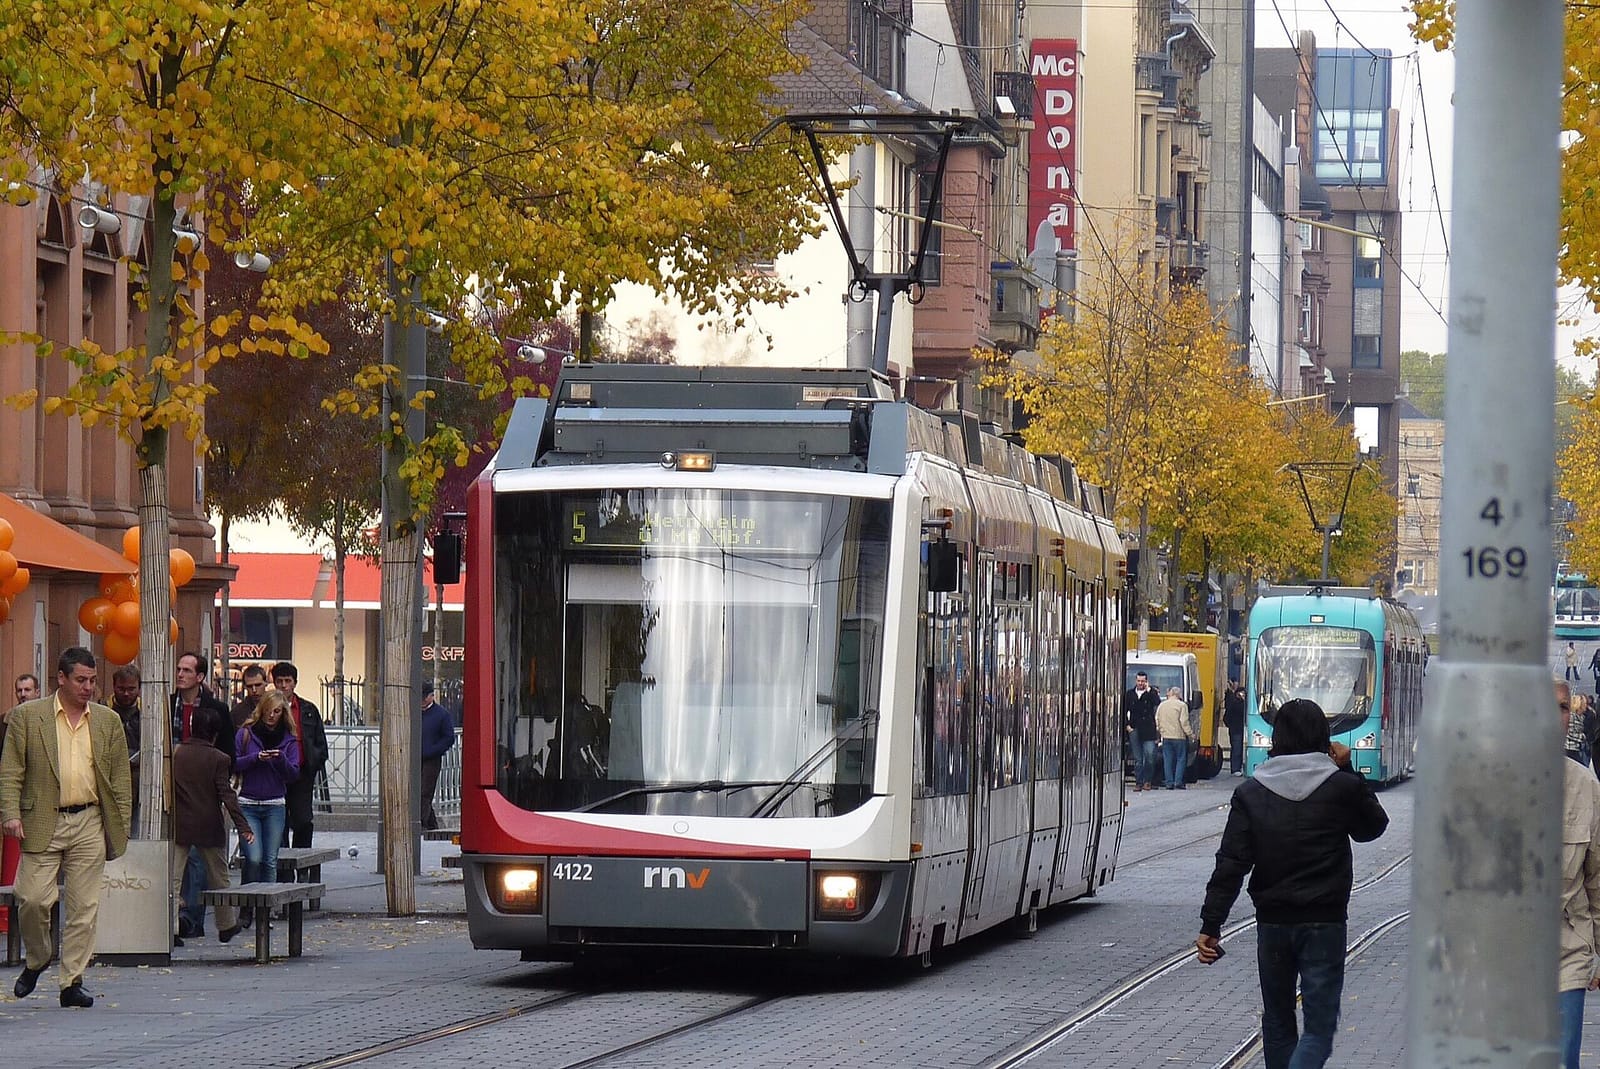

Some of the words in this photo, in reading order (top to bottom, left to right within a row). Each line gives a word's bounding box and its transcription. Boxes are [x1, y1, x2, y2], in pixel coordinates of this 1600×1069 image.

[1031, 54, 1075, 252] McDona
[1480, 497, 1503, 526] 4
[572, 511, 585, 543] 5
[713, 528, 761, 545] Hbf.
[1463, 547, 1527, 579] 169
[552, 863, 593, 881] 4122
[644, 866, 711, 889] rnv
